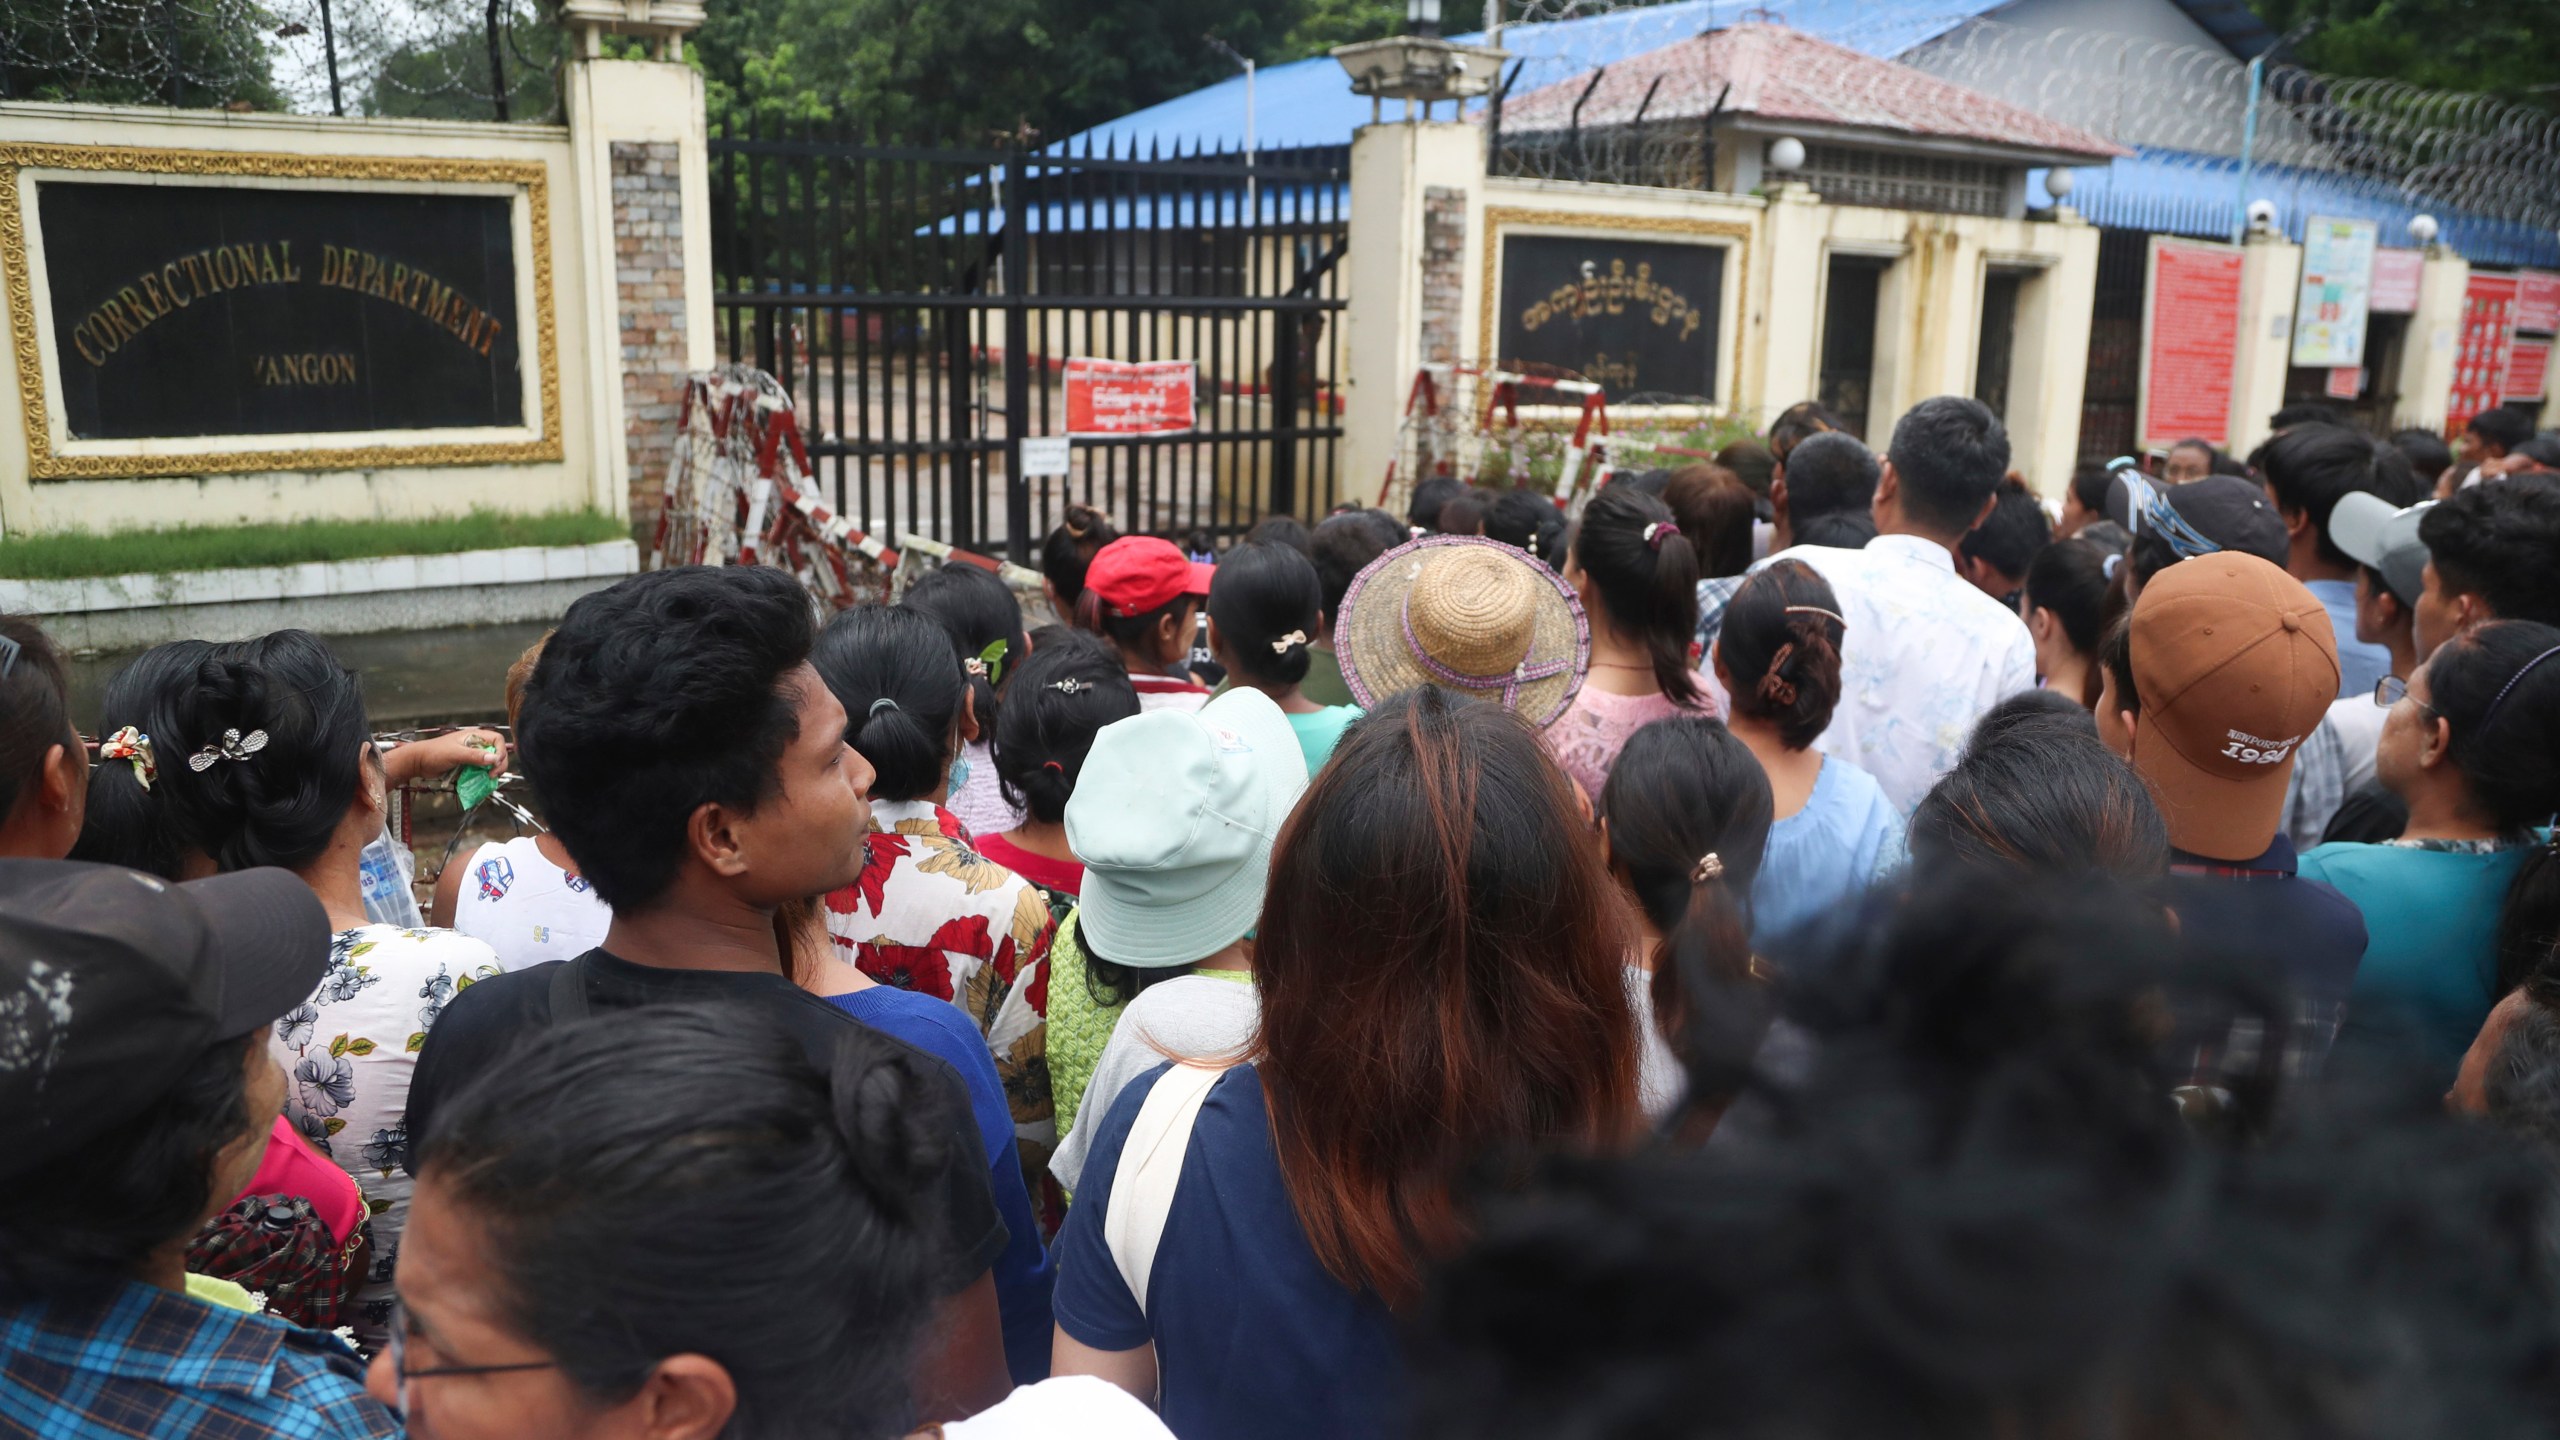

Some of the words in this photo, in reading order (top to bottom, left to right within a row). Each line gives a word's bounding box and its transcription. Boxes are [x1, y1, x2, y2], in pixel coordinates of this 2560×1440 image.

[74, 240, 300, 366] CORRECTIONAL
[320, 244, 502, 358] DEPARTMENT
[2226, 728, 2280, 749] NEWPORT
[533, 925, 550, 944] 95
